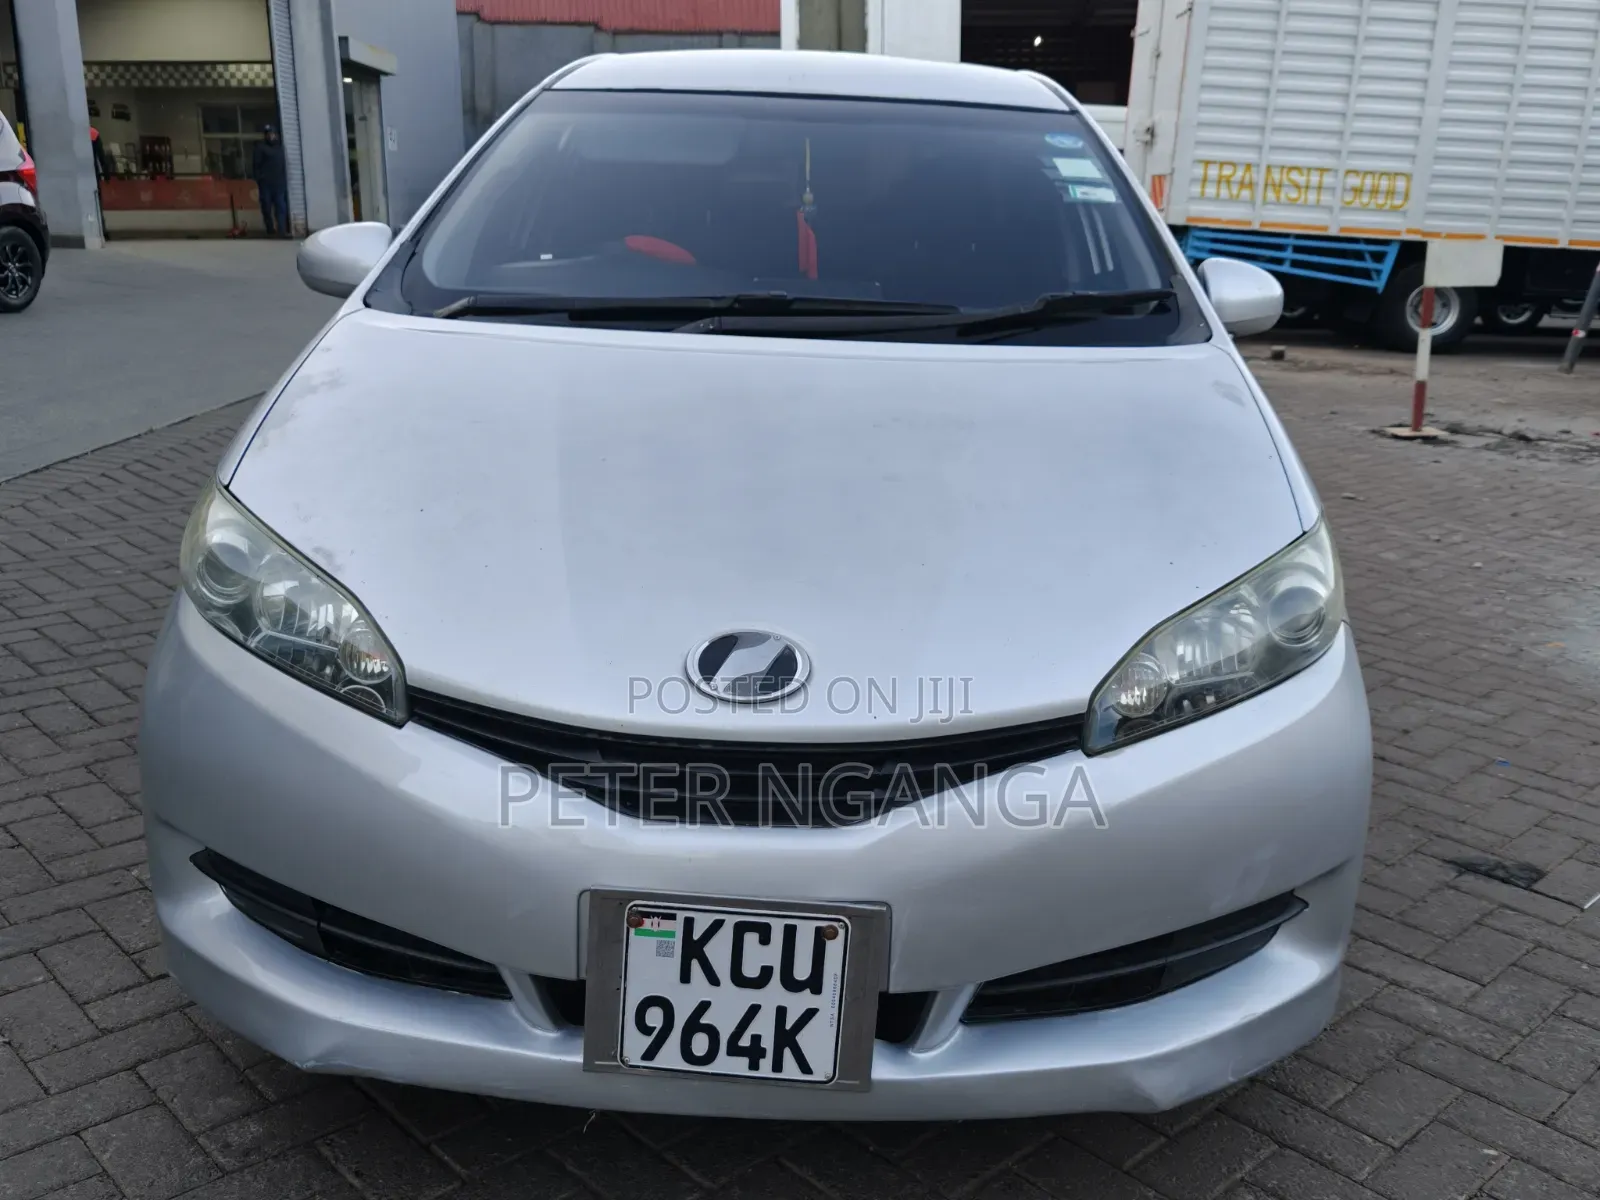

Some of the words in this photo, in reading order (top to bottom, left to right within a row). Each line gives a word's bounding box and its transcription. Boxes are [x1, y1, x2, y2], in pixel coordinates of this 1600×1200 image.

[1197, 160, 1331, 206] TRANSIT
[1341, 170, 1411, 211] GOOD
[679, 916, 827, 996] KCU
[634, 995, 820, 1075] 964K
